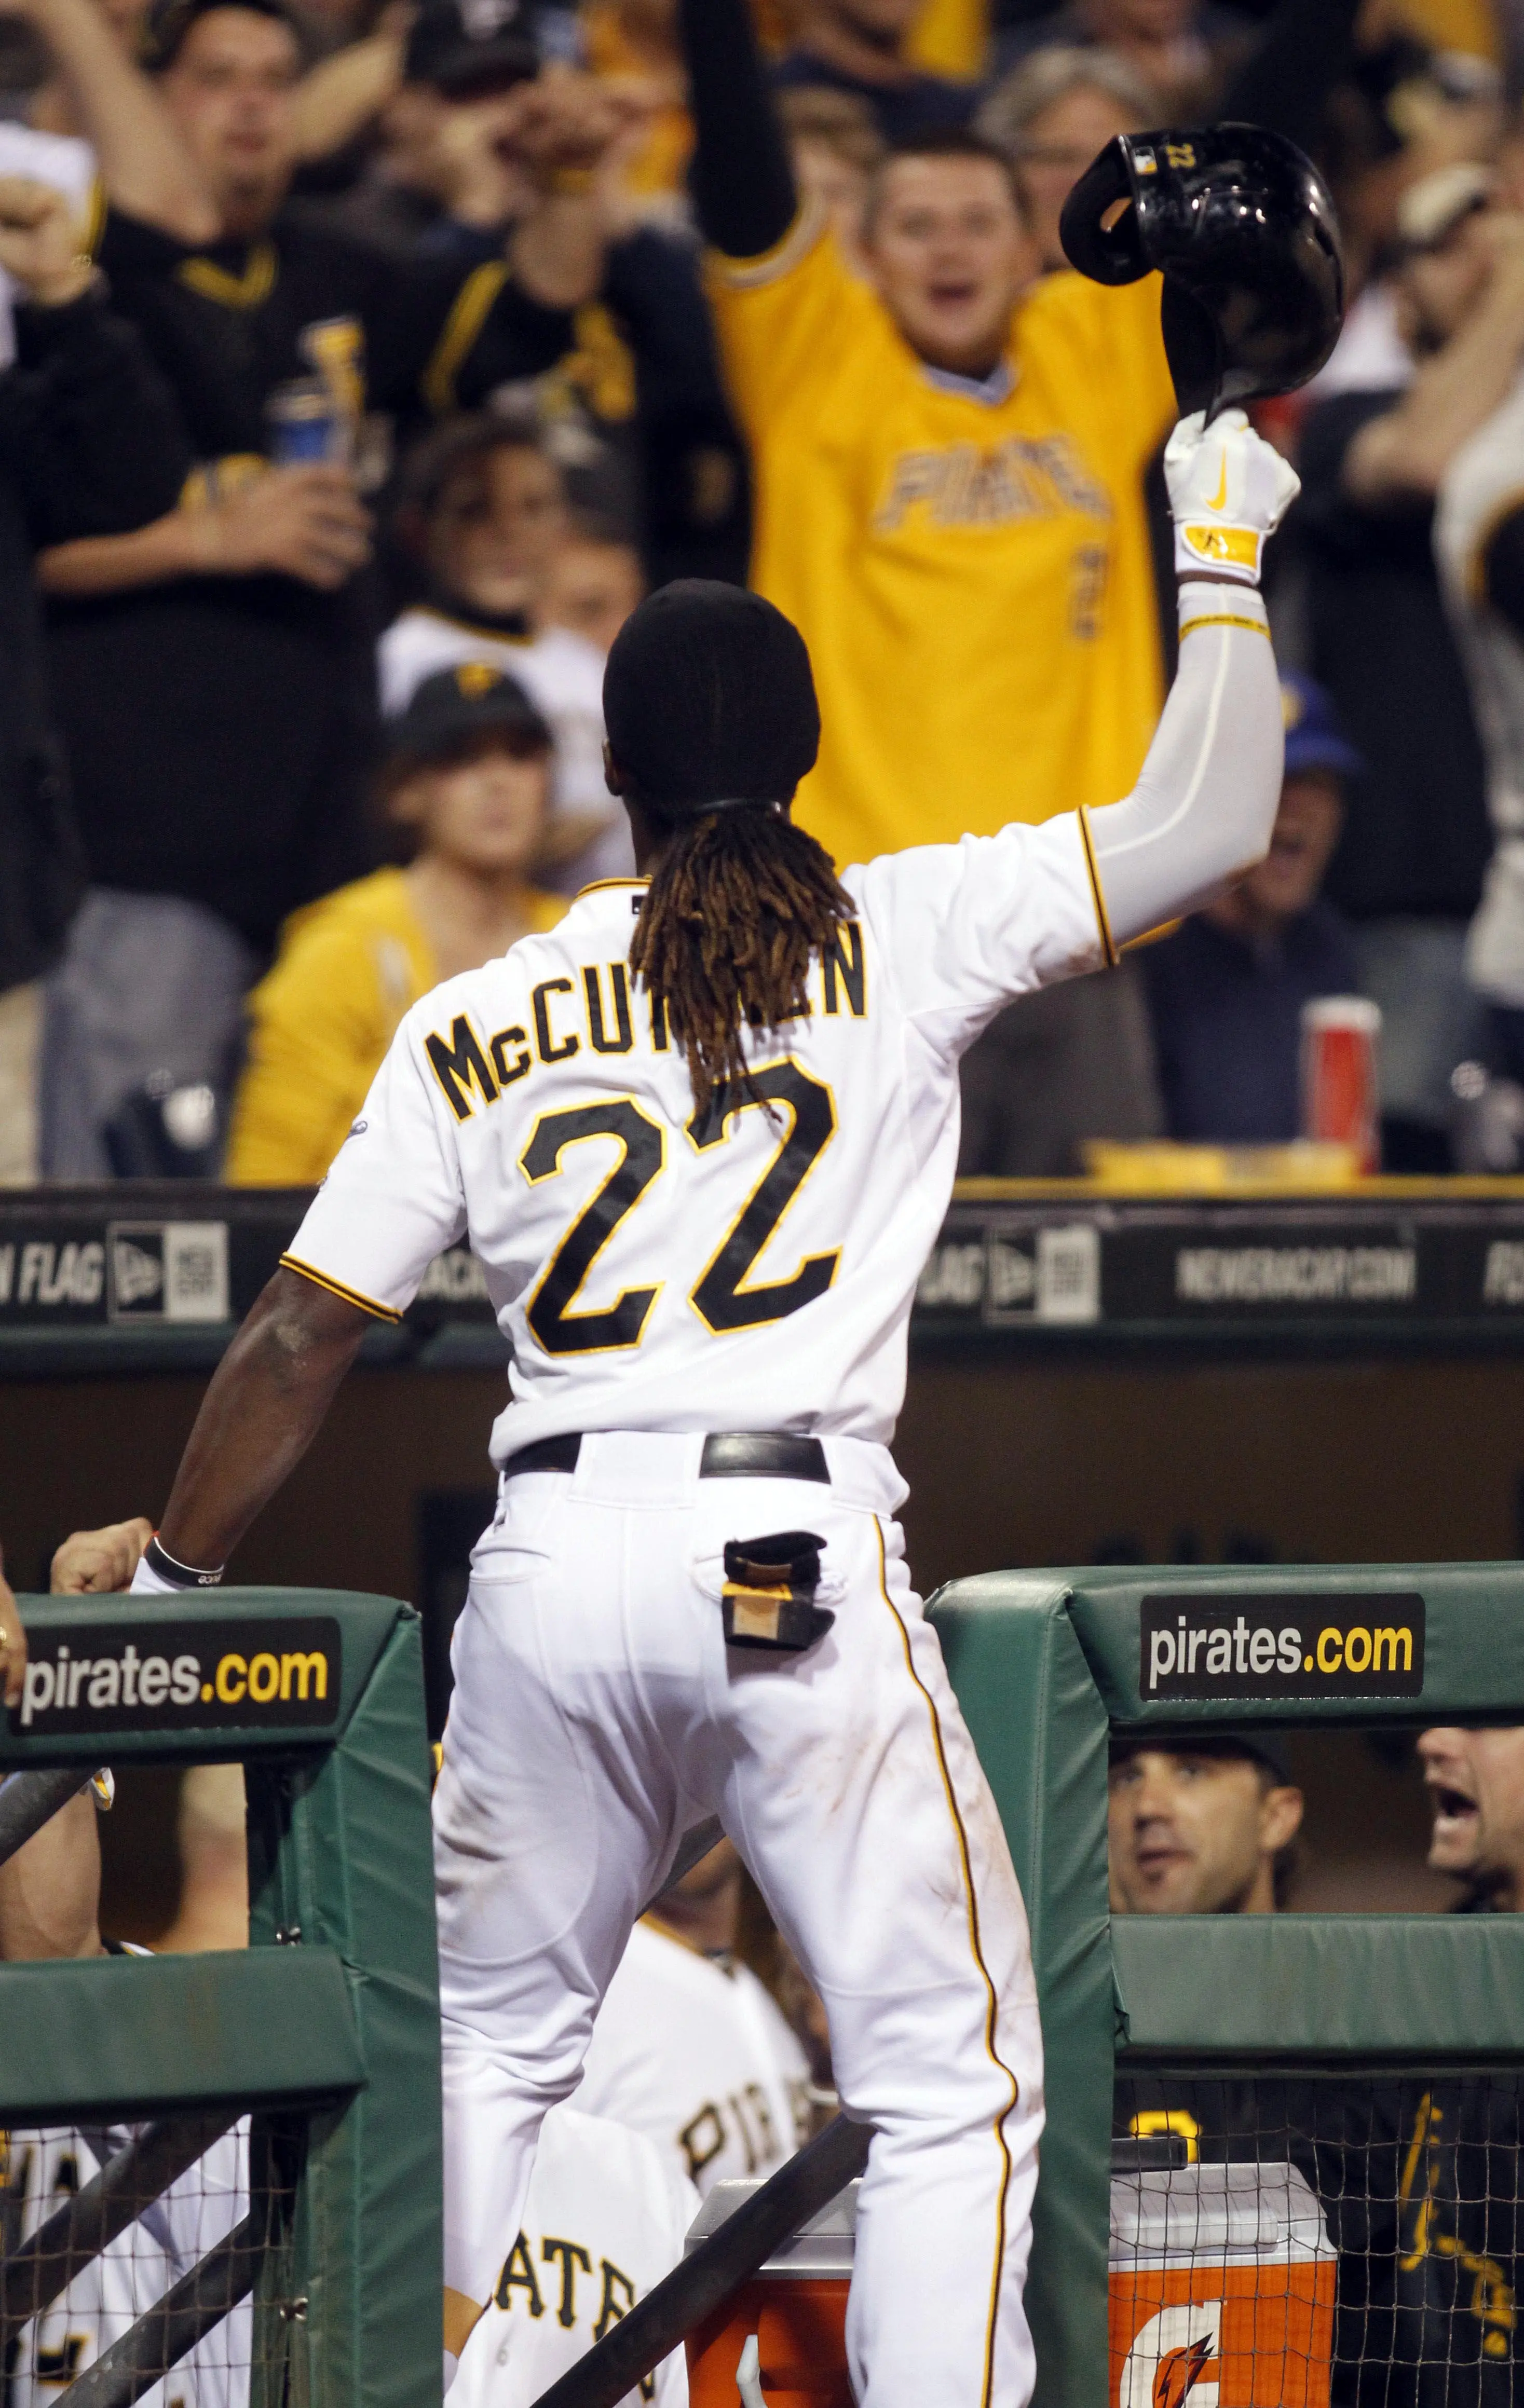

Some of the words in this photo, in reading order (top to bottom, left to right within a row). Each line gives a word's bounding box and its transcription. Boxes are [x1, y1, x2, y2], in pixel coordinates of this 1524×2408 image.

[1166, 144, 1196, 169] 22
[425, 920, 868, 1125] McCUN
[518, 1056, 843, 1361] 22
[20, 1644, 329, 1727] pirates.com
[1149, 1615, 1413, 1689] pirates.com
